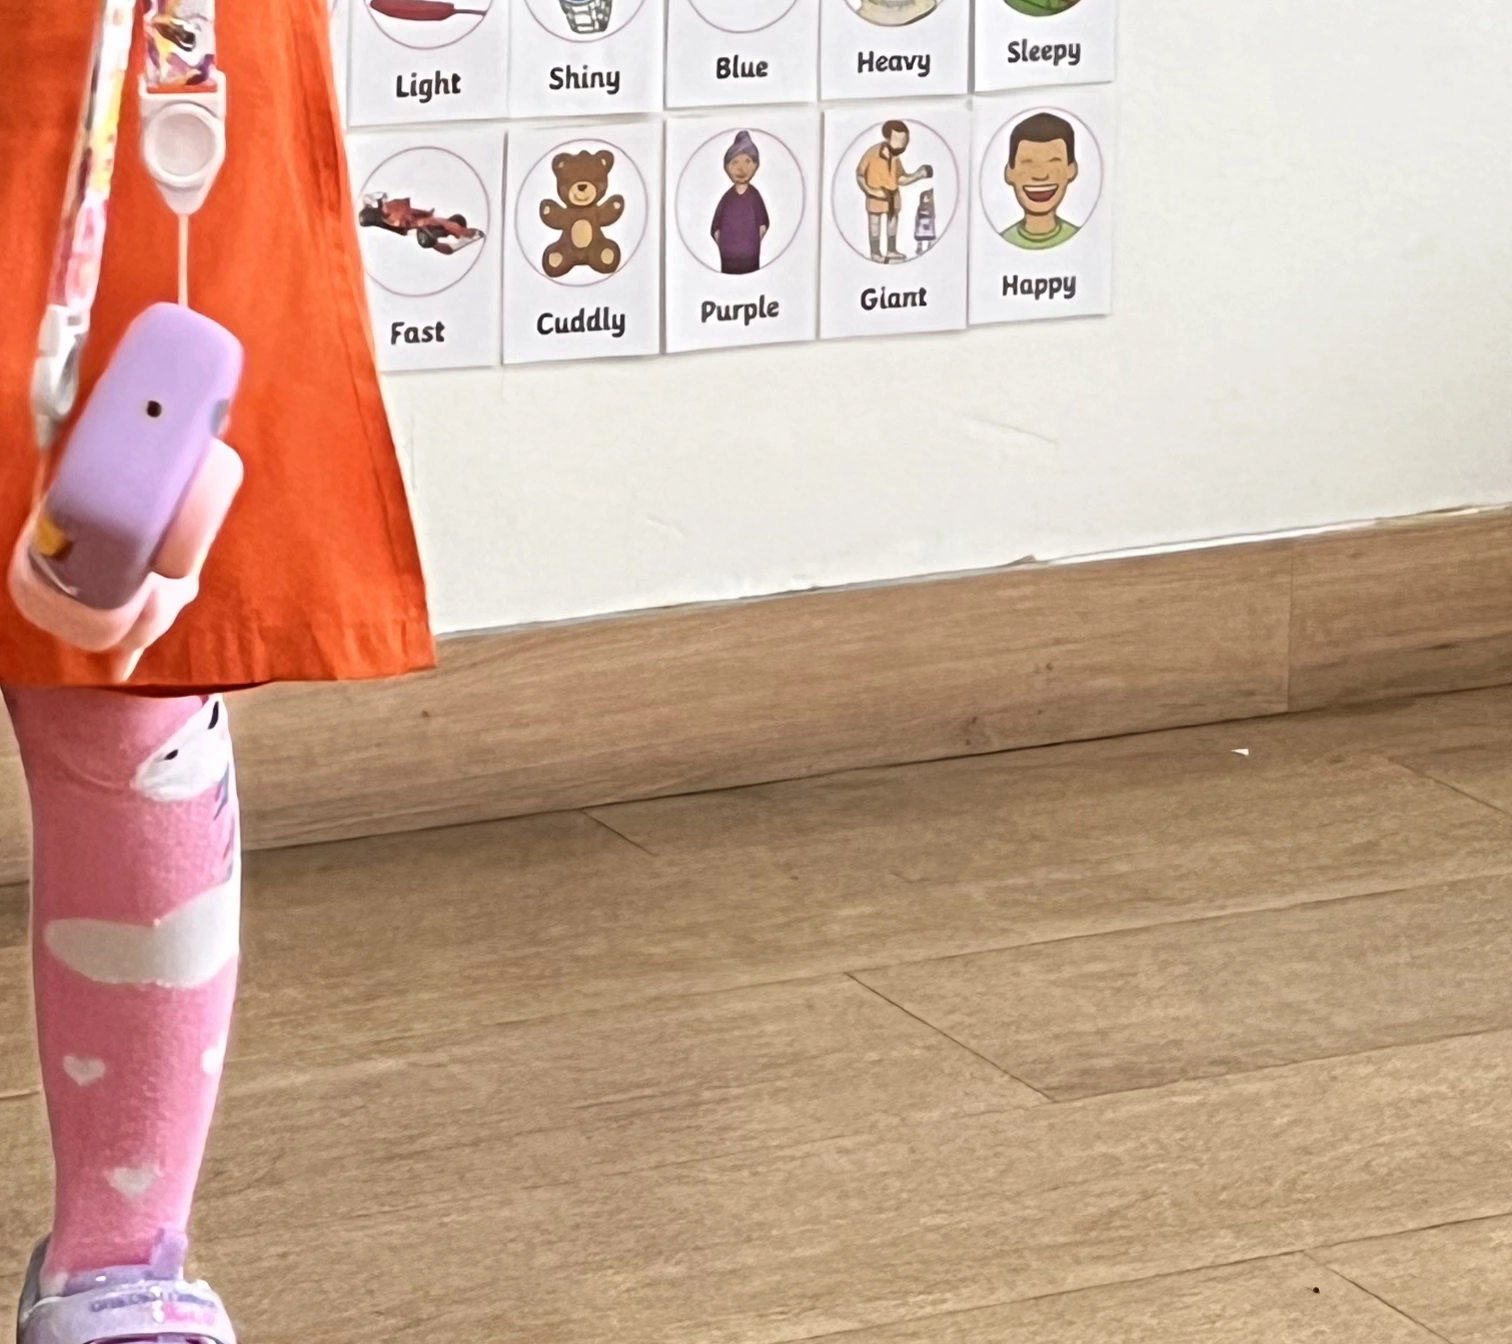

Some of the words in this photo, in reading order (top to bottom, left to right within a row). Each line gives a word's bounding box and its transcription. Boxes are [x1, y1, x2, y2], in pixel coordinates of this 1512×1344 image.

[857, 51, 931, 77] Heavy
[1007, 40, 1081, 66] Sleepy
[549, 66, 621, 95] Shiny
[716, 56, 769, 79] Blue
[396, 71, 461, 103] Light
[860, 287, 928, 311] Giant
[1002, 274, 1077, 299] Happy
[537, 307, 626, 337] Cuddly
[701, 295, 780, 326] Purple
[390, 321, 445, 345] Fast
